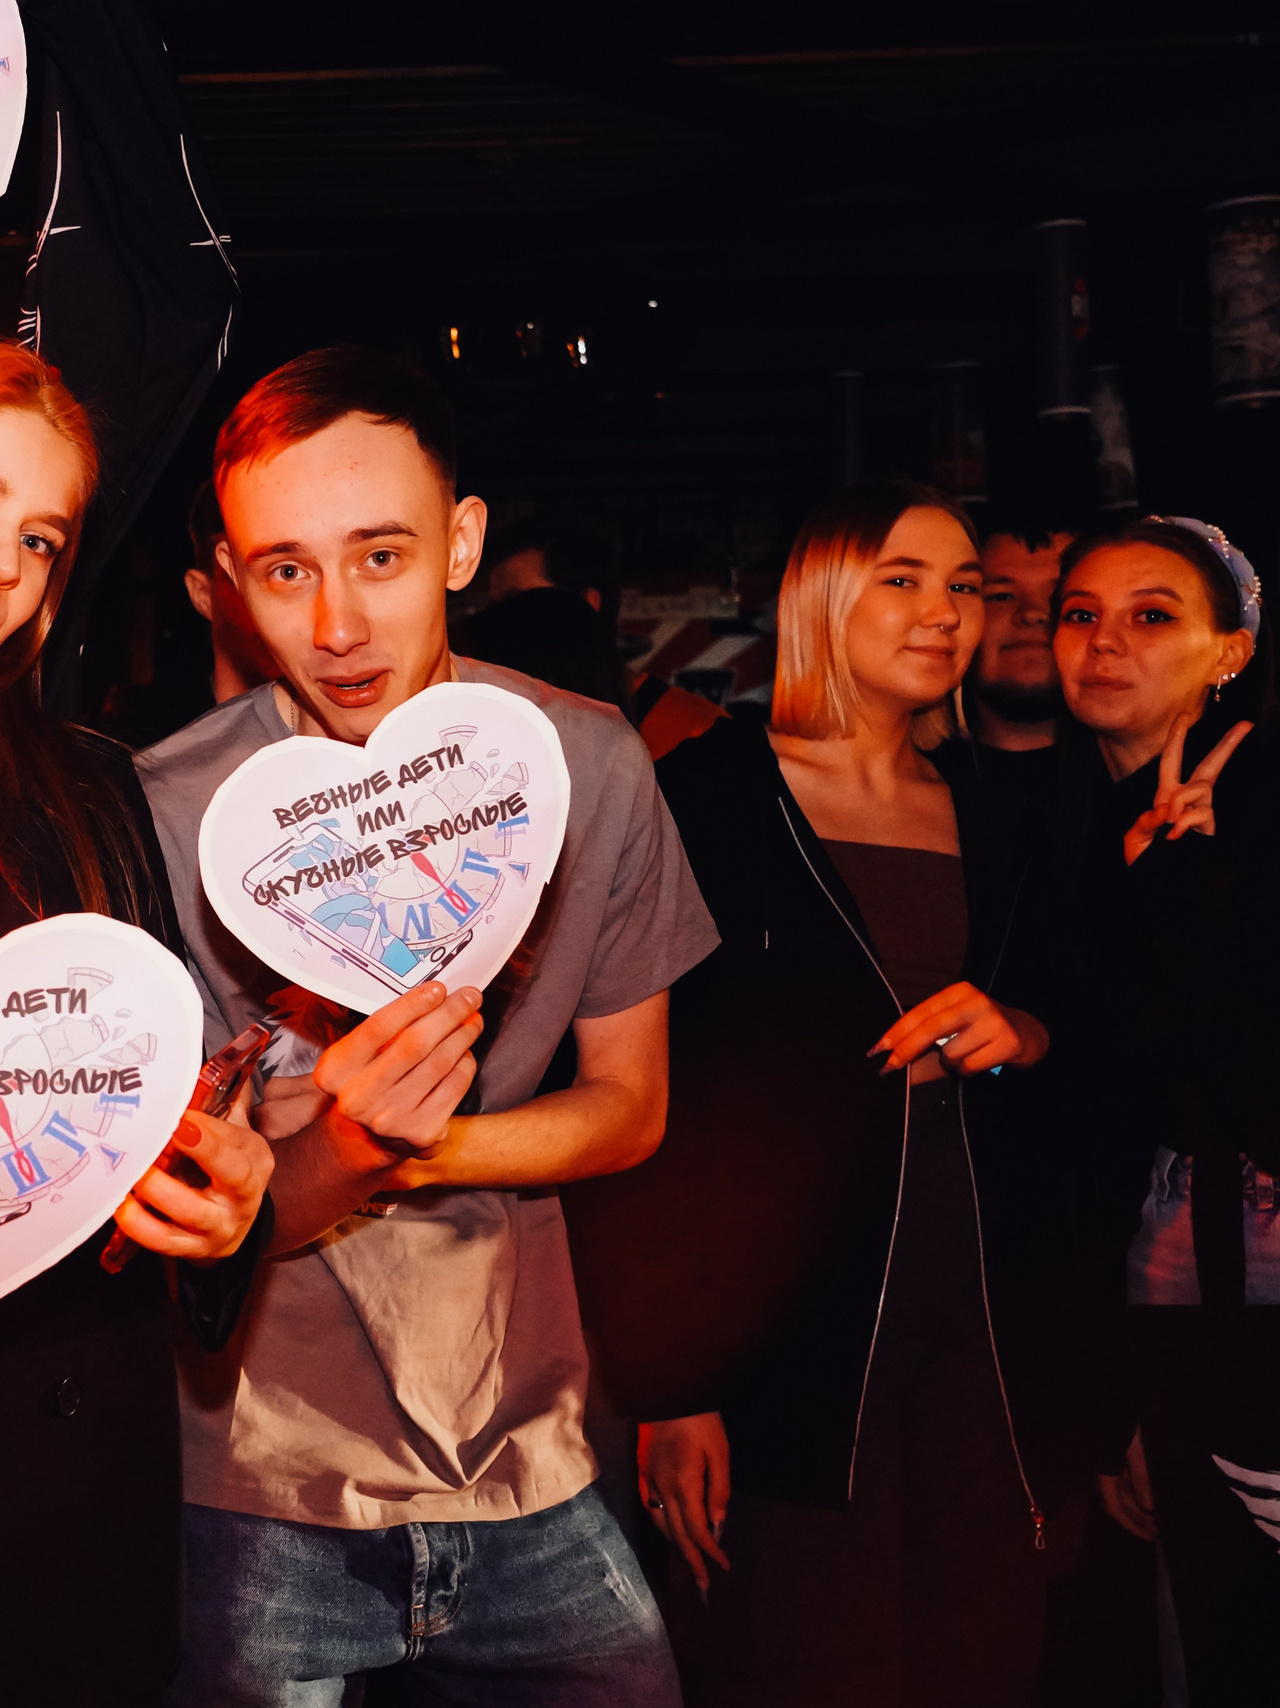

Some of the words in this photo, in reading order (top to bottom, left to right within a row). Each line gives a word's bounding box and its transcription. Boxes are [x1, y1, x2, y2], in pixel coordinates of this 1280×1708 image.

[272, 769, 392, 830] ВЕЧНЫЕ
[397, 743, 465, 789] ДЕТИ
[357, 800, 406, 836] ИЛИ
[253, 843, 385, 907] СКУЧНЫЕ
[386, 792, 528, 860] ВЗРОСЛЫЕ
[2, 987, 87, 1018] ДЕТИ
